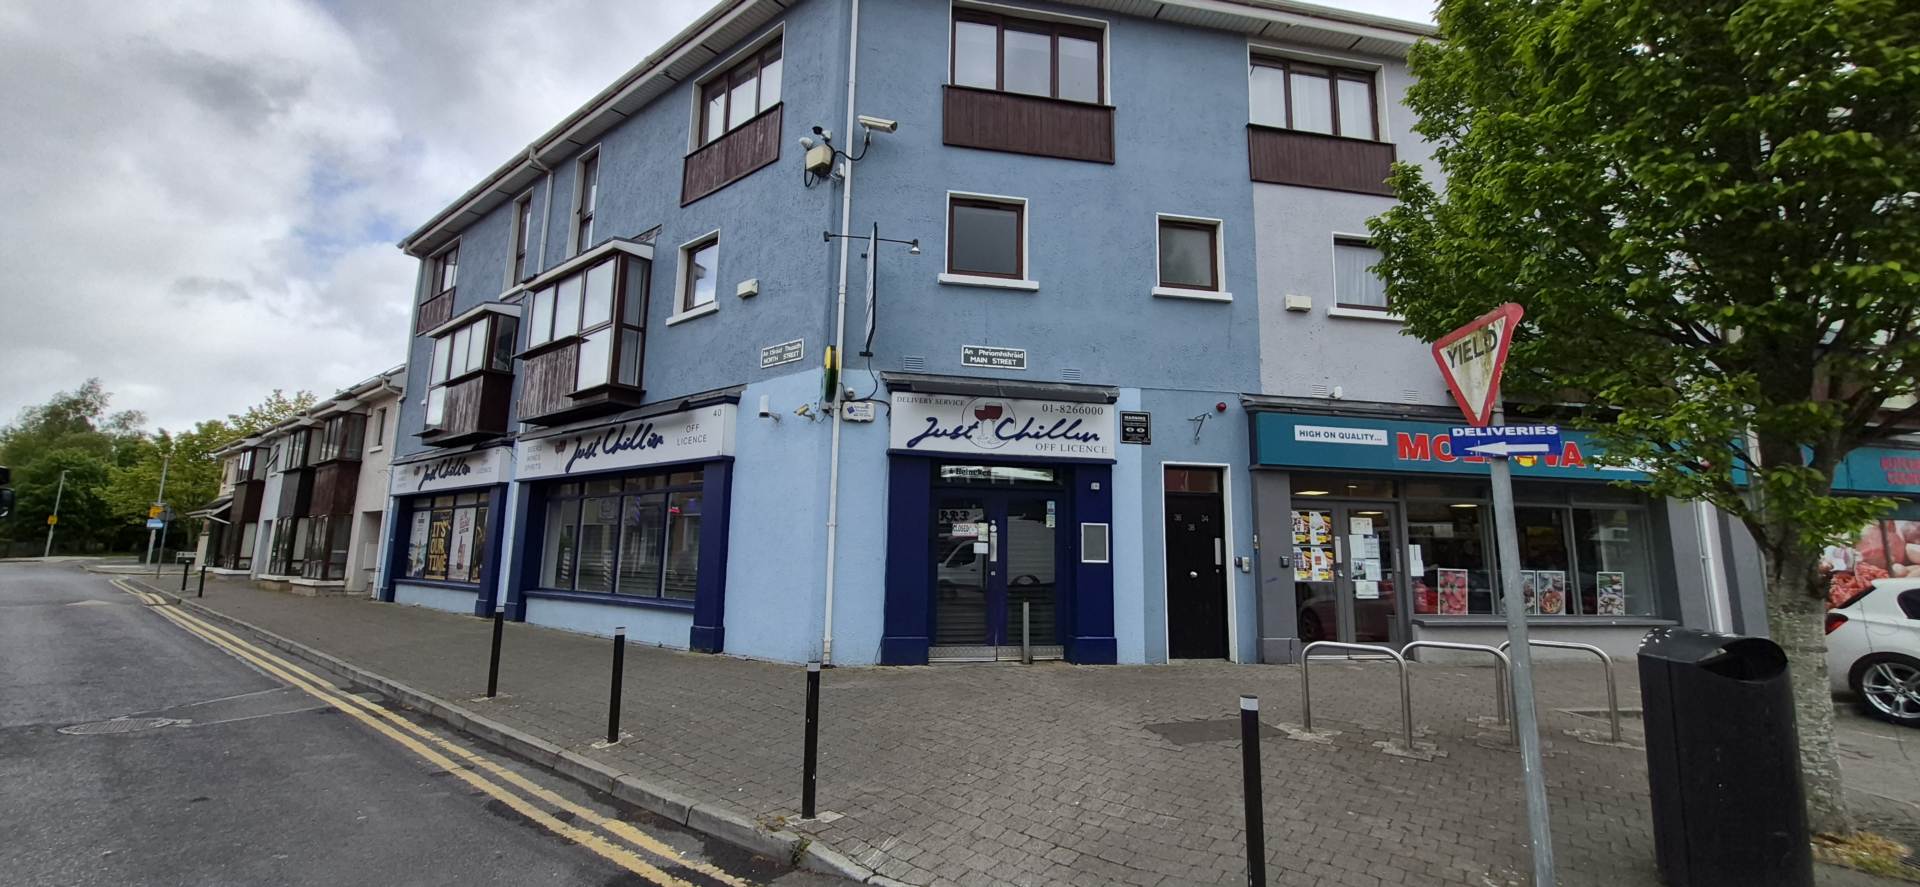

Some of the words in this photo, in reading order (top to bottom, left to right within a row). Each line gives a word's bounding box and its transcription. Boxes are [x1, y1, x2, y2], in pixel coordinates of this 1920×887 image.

[1447, 329, 1498, 368] YIELD
[783, 350, 800, 360] STREET
[970, 356, 988, 364] MAIN
[992, 357, 1017, 366] STREET
[897, 396, 933, 405] DELIVERY
[934, 398, 964, 406] SERVICE
[712, 408, 722, 417] 40
[1042, 403, 1104, 416] 01-8266000
[686, 423, 700, 434] OFF
[907, 416, 979, 448] Just
[1299, 429, 1320, 438] HIGH
[1323, 431, 1336, 439] ON
[1452, 425, 1559, 437] DELIVERIES
[676, 434, 708, 447] LICENCE
[1035, 442, 1057, 452] OFF
[1060, 443, 1109, 454] LICENCE
[565, 435, 602, 474] Just
[955, 467, 991, 477] Heineken
